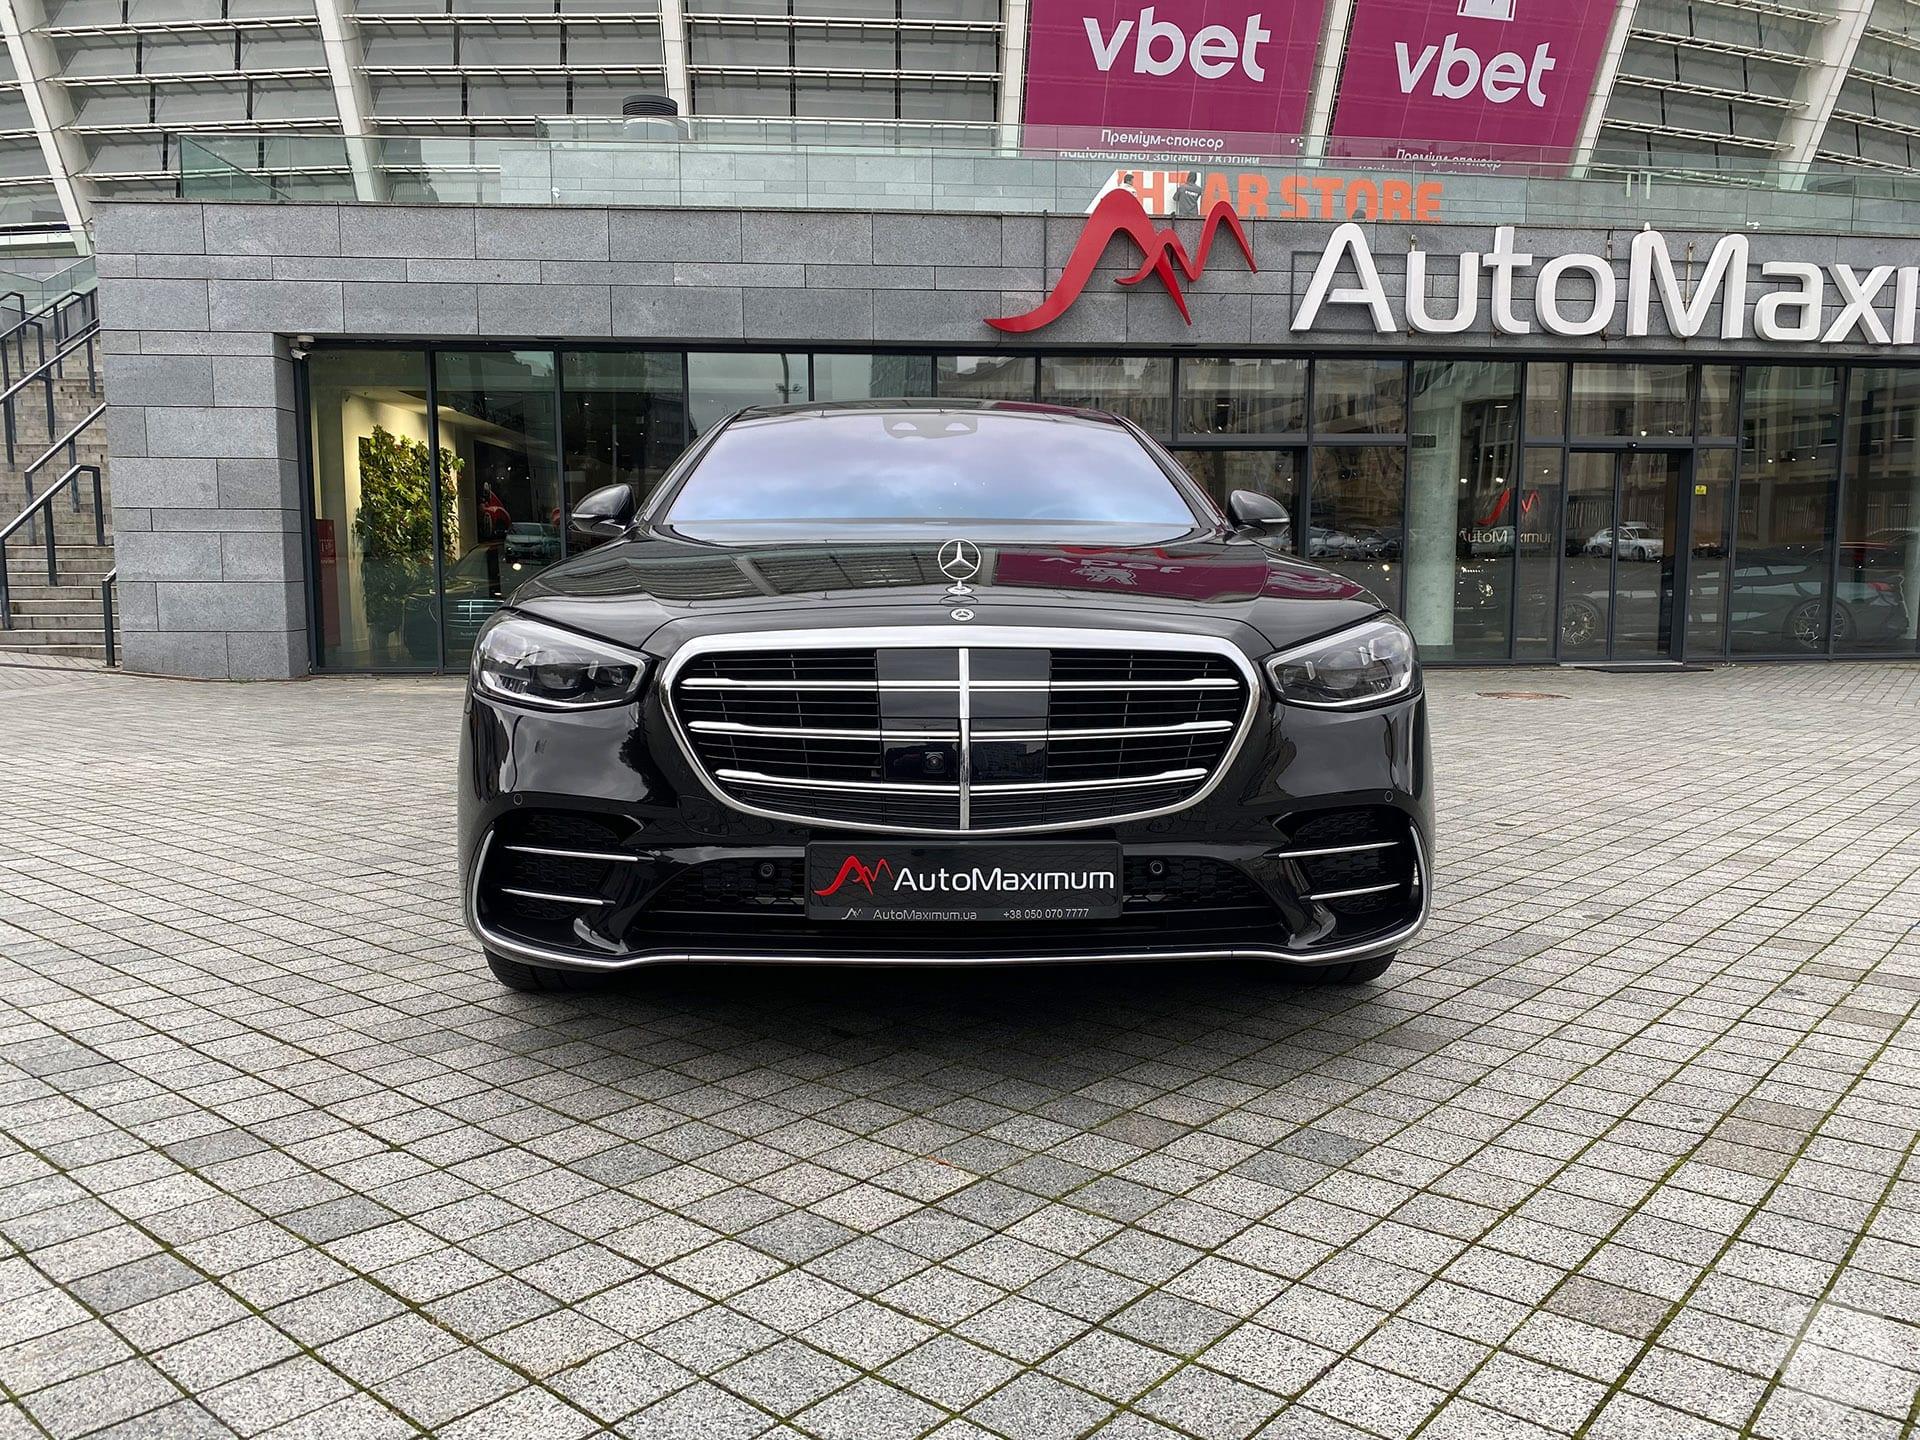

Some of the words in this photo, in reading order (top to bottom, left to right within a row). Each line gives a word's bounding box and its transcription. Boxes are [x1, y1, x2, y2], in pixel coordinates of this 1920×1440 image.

[1083, 6, 1271, 83] vbet
[1395, 32, 1556, 108] vbet
[1100, 128, 1224, 151] Преміум-спонсор
[1279, 174, 1443, 222] STORE
[893, 867, 1114, 891] AutoMaximum
[872, 909, 977, 920] AutoMaximum.ua
[1003, 909, 1022, 919] +38
[1024, 909, 1041, 919] 050
[1045, 909, 1063, 919] 070
[1065, 908, 1090, 918] 7777
